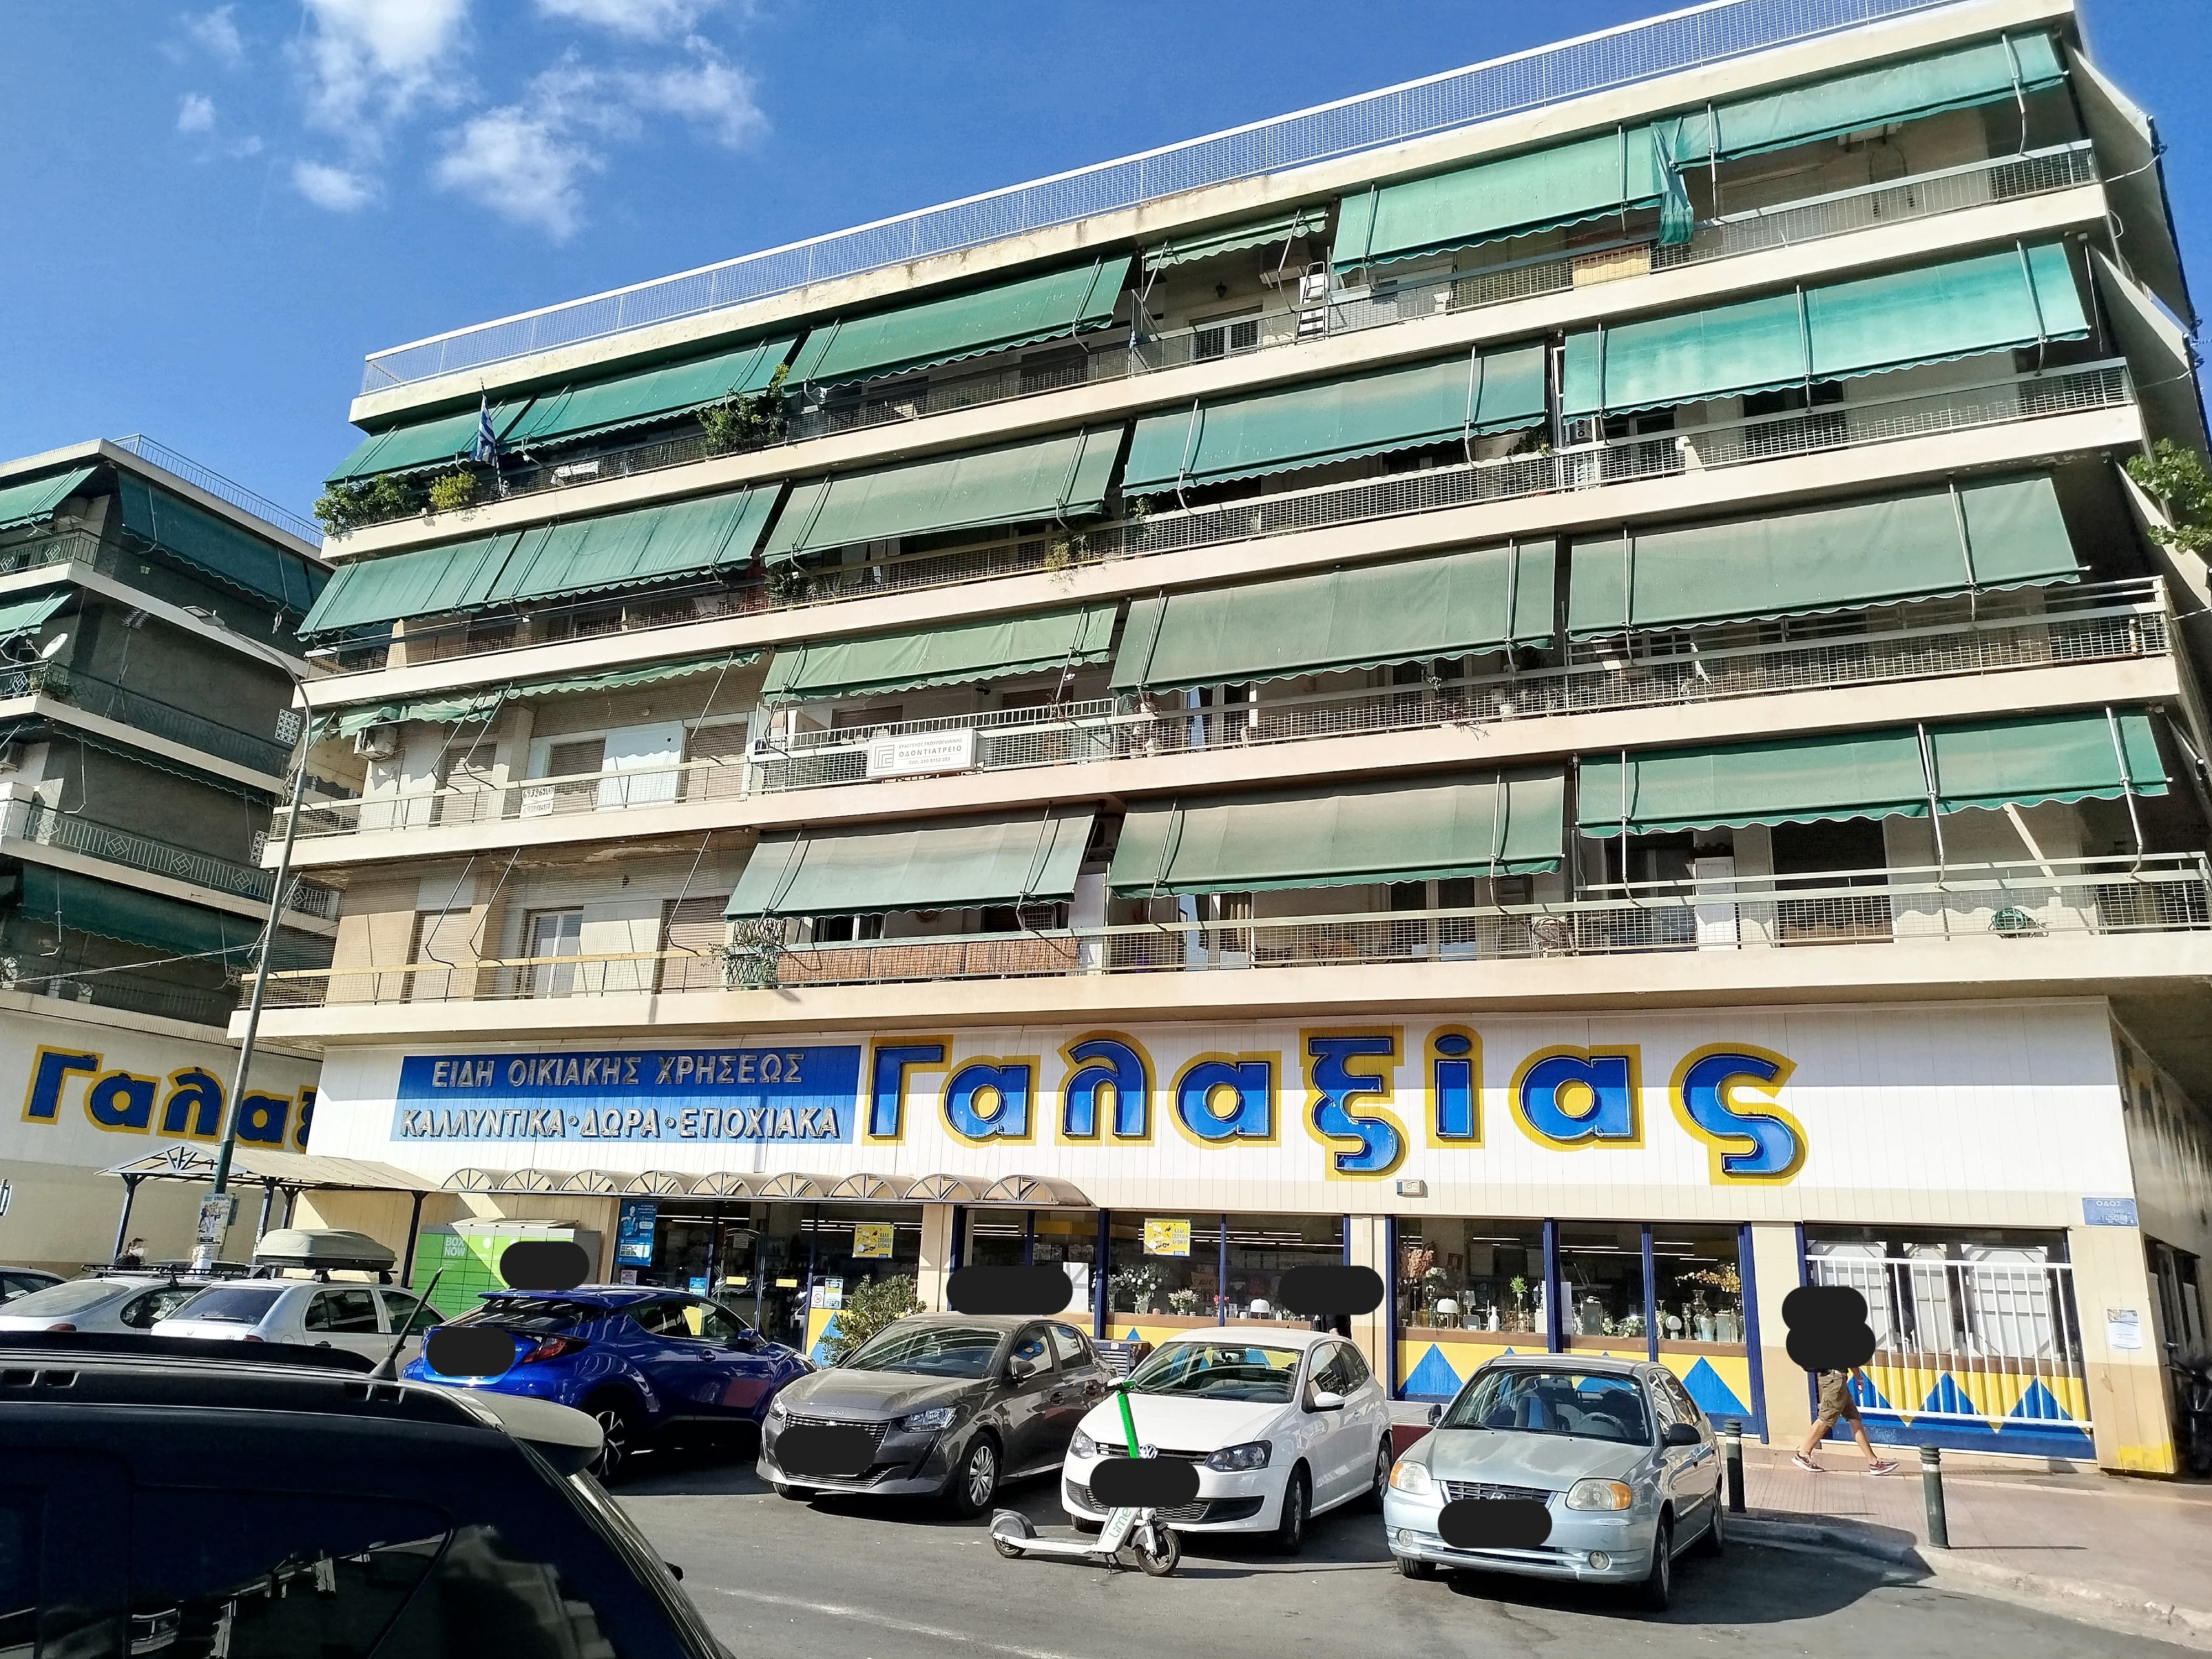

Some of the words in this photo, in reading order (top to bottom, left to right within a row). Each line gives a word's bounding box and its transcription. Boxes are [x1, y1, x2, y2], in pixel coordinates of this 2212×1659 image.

[899, 745, 962, 758] ΟΔΟΝΤΙΑΤΡΕΙΟ
[432, 1061, 495, 1088] ΕΙΔΗ
[508, 1057, 642, 1087] ΟΙΚΙΑΚΗΣ
[655, 1053, 805, 1085] ΧΡΗΣΕΩΣ
[445, 1237, 465, 1247] BOX
[444, 1247, 466, 1257] NOW
